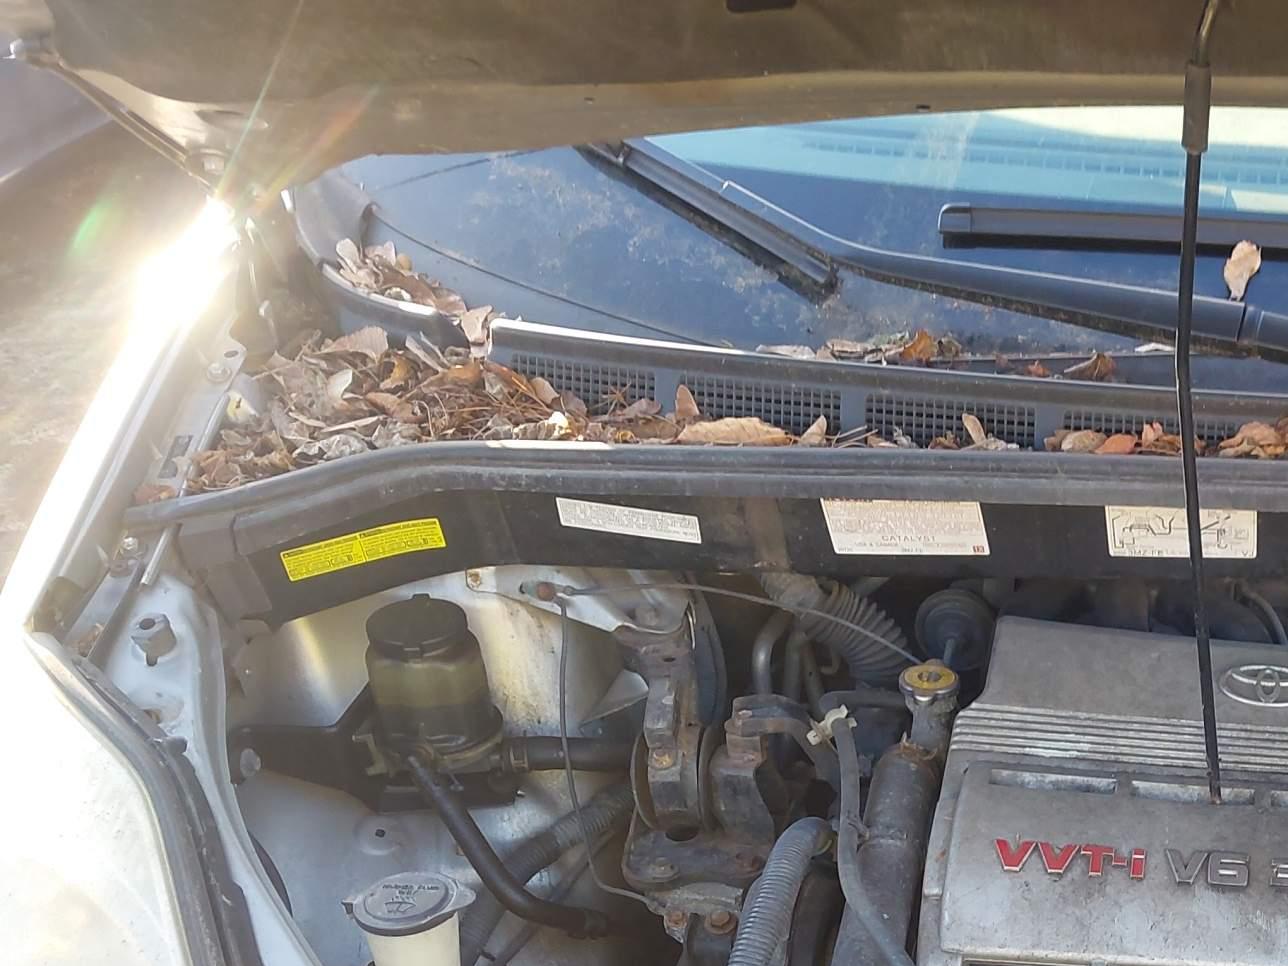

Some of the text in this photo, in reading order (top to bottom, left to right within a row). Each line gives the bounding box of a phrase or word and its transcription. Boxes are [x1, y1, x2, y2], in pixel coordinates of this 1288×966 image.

[882, 534, 936, 542] CATALYST
[995, 838, 1147, 880] VVT-i
[1165, 848, 1251, 887] V6
